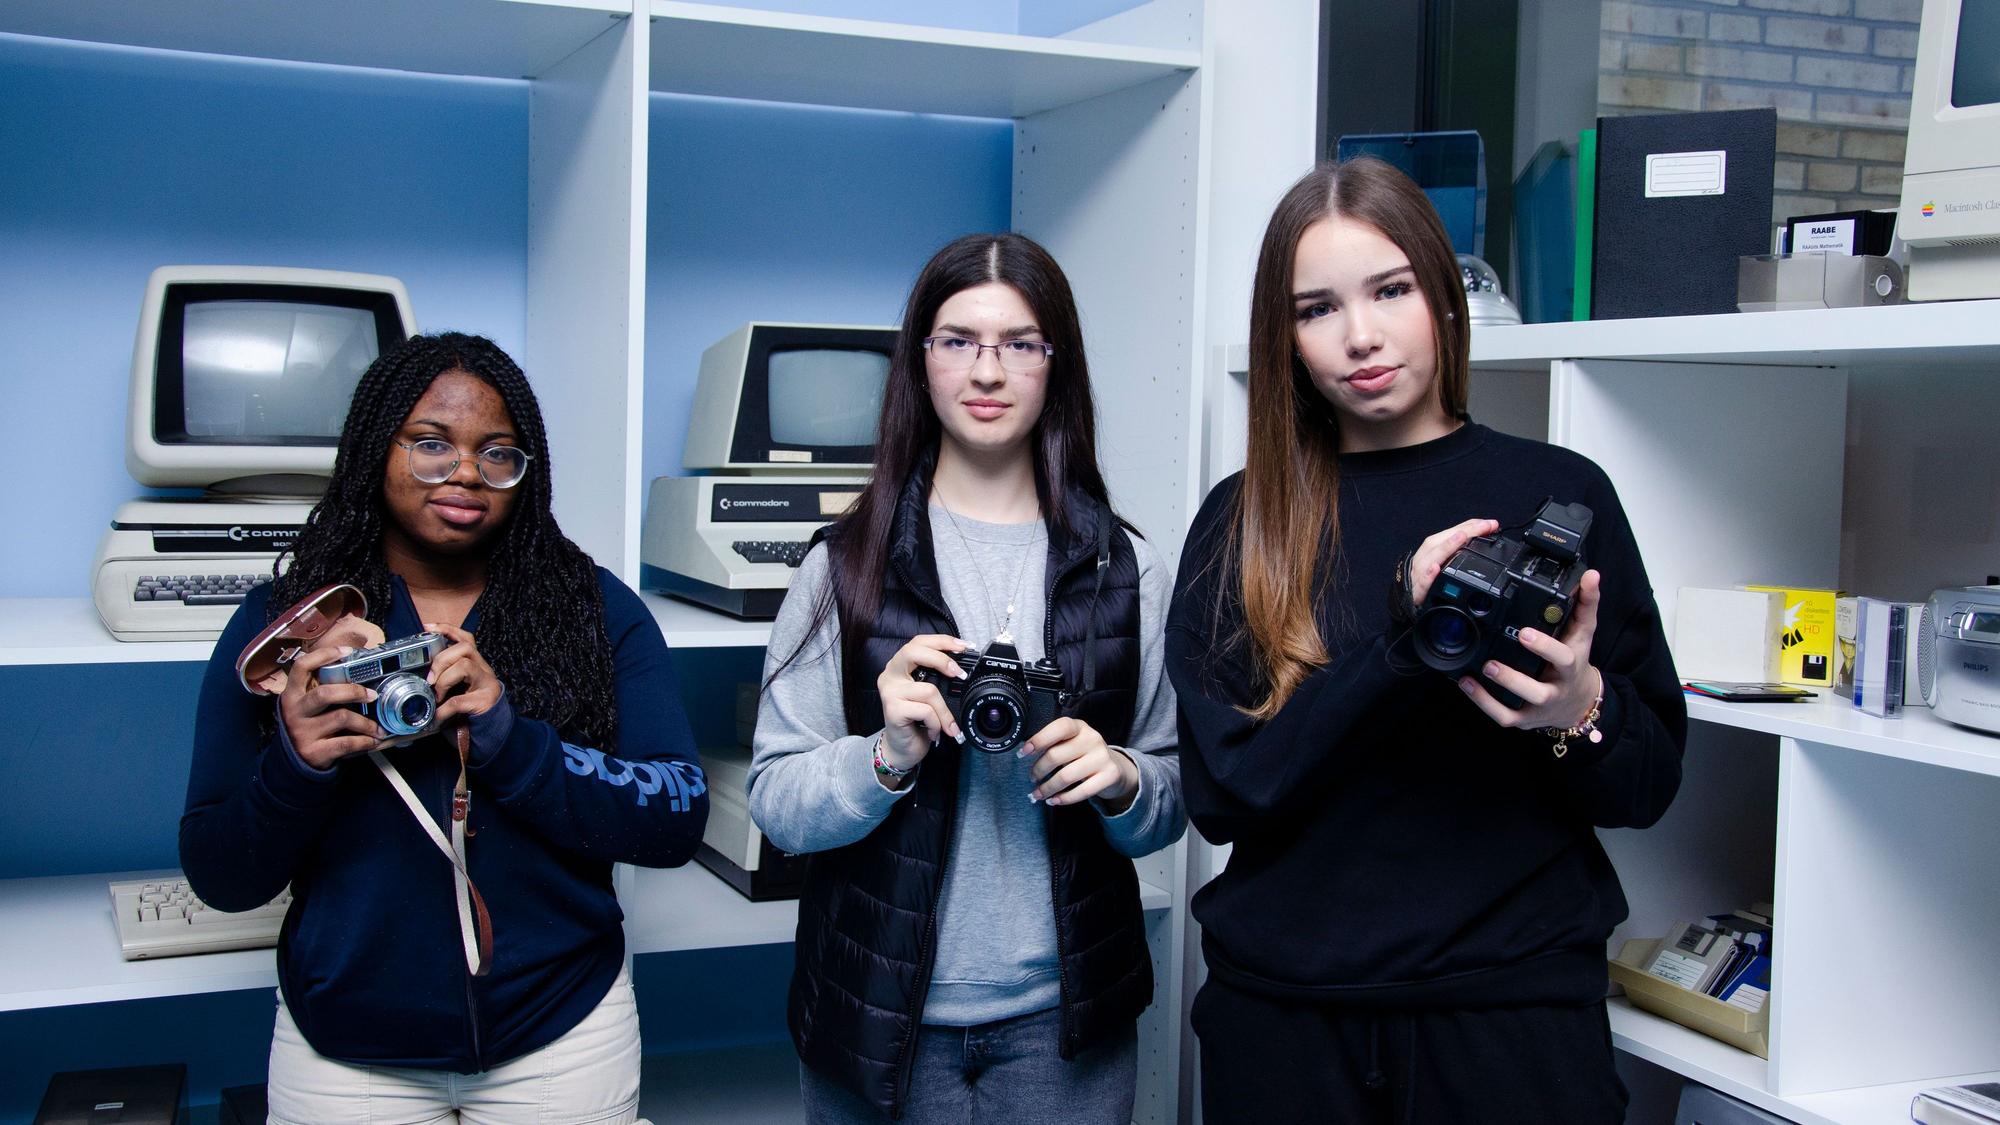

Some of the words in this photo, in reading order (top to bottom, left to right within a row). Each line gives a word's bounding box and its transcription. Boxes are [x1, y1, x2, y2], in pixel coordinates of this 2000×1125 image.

[1944, 200, 1983, 214] Macintosh
[1811, 226, 1836, 235] RAABE
[732, 499, 790, 508] commodore
[1542, 531, 1567, 544] SHARP
[1803, 624, 1821, 634] HD
[1963, 662, 1989, 672] PHILIPS
